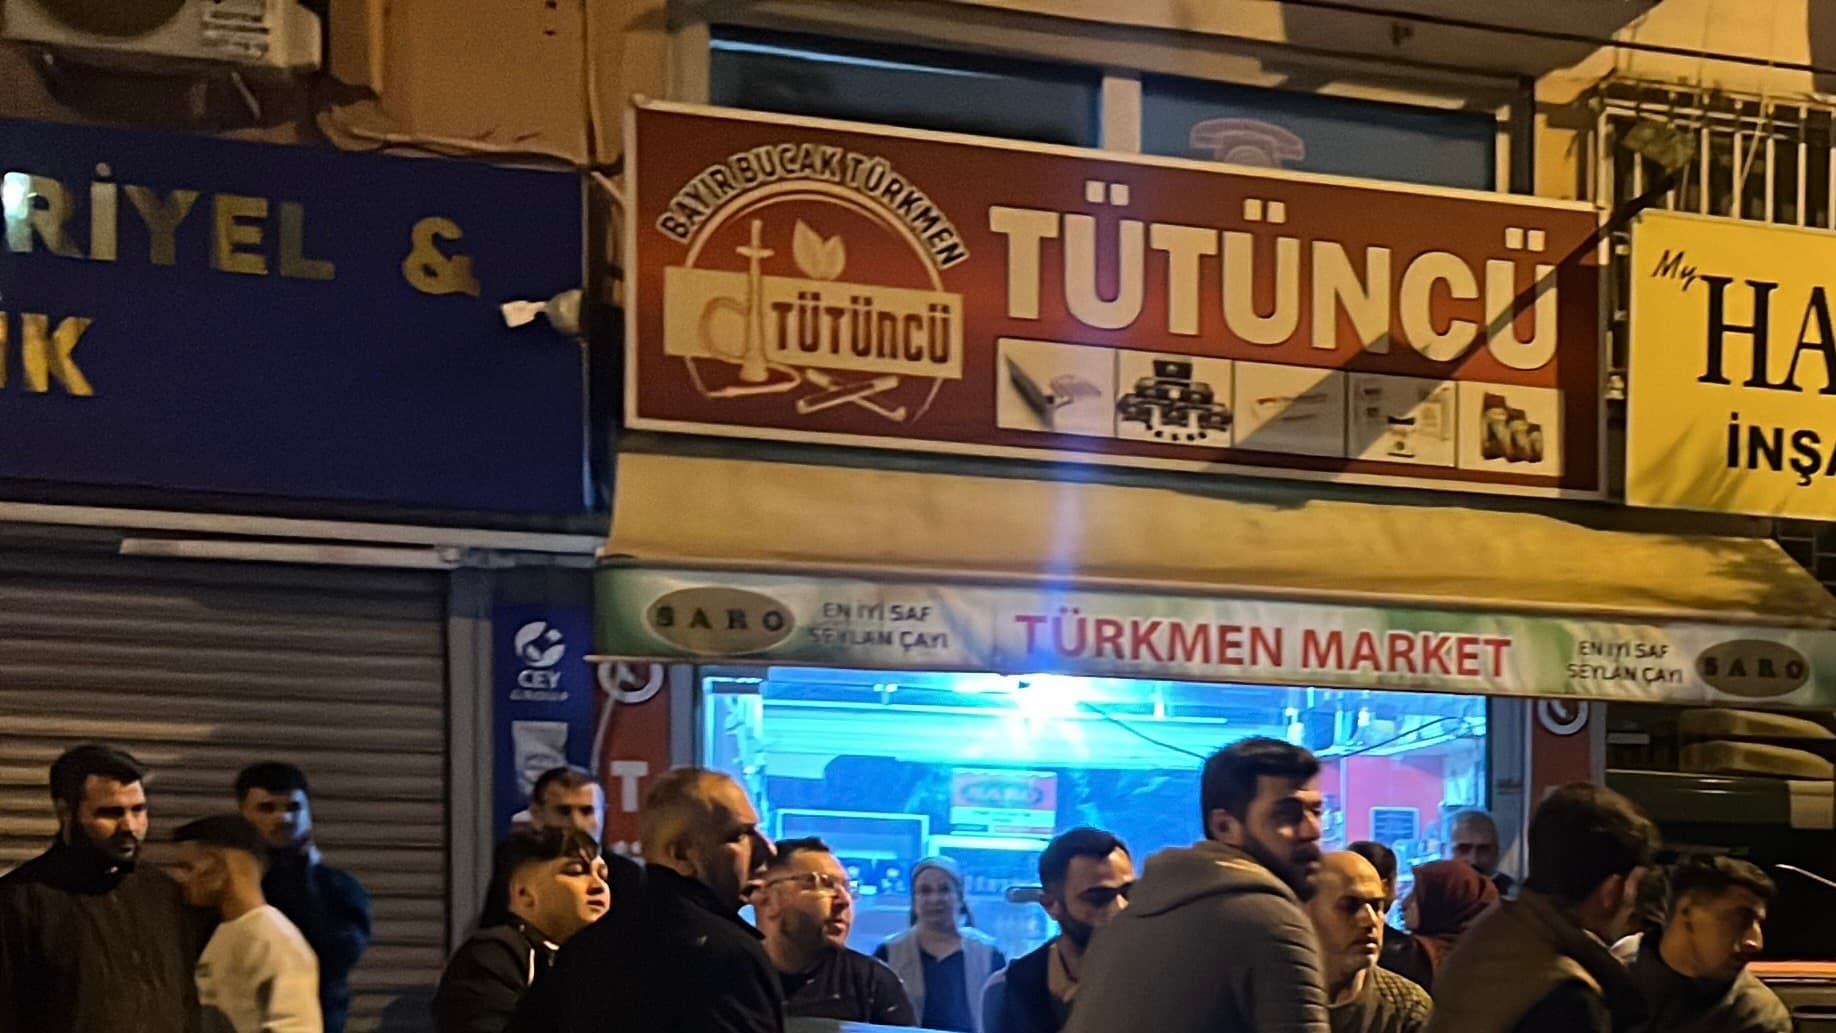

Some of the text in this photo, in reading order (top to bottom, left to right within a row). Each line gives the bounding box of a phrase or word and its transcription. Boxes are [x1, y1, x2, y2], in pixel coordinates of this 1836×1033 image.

[658, 144, 967, 267] BAYIR BUCAK TÜRKMEN
[2, 162, 480, 296] RİYEL &
[989, 180, 1559, 371] TÜTÜNCÜ
[1650, 249, 1697, 292] My
[771, 290, 951, 364] TÜTÜNCÜ
[655, 604, 785, 632] SARO
[823, 601, 850, 620] EN
[890, 604, 933, 622] SAF
[1015, 607, 1512, 677] TÜRKMEN MARKET
[1579, 640, 1603, 656] EN
[1635, 643, 1669, 659] SAF
[1567, 662, 1638, 682] SEYLAN
[1703, 657, 1803, 680] SARO
